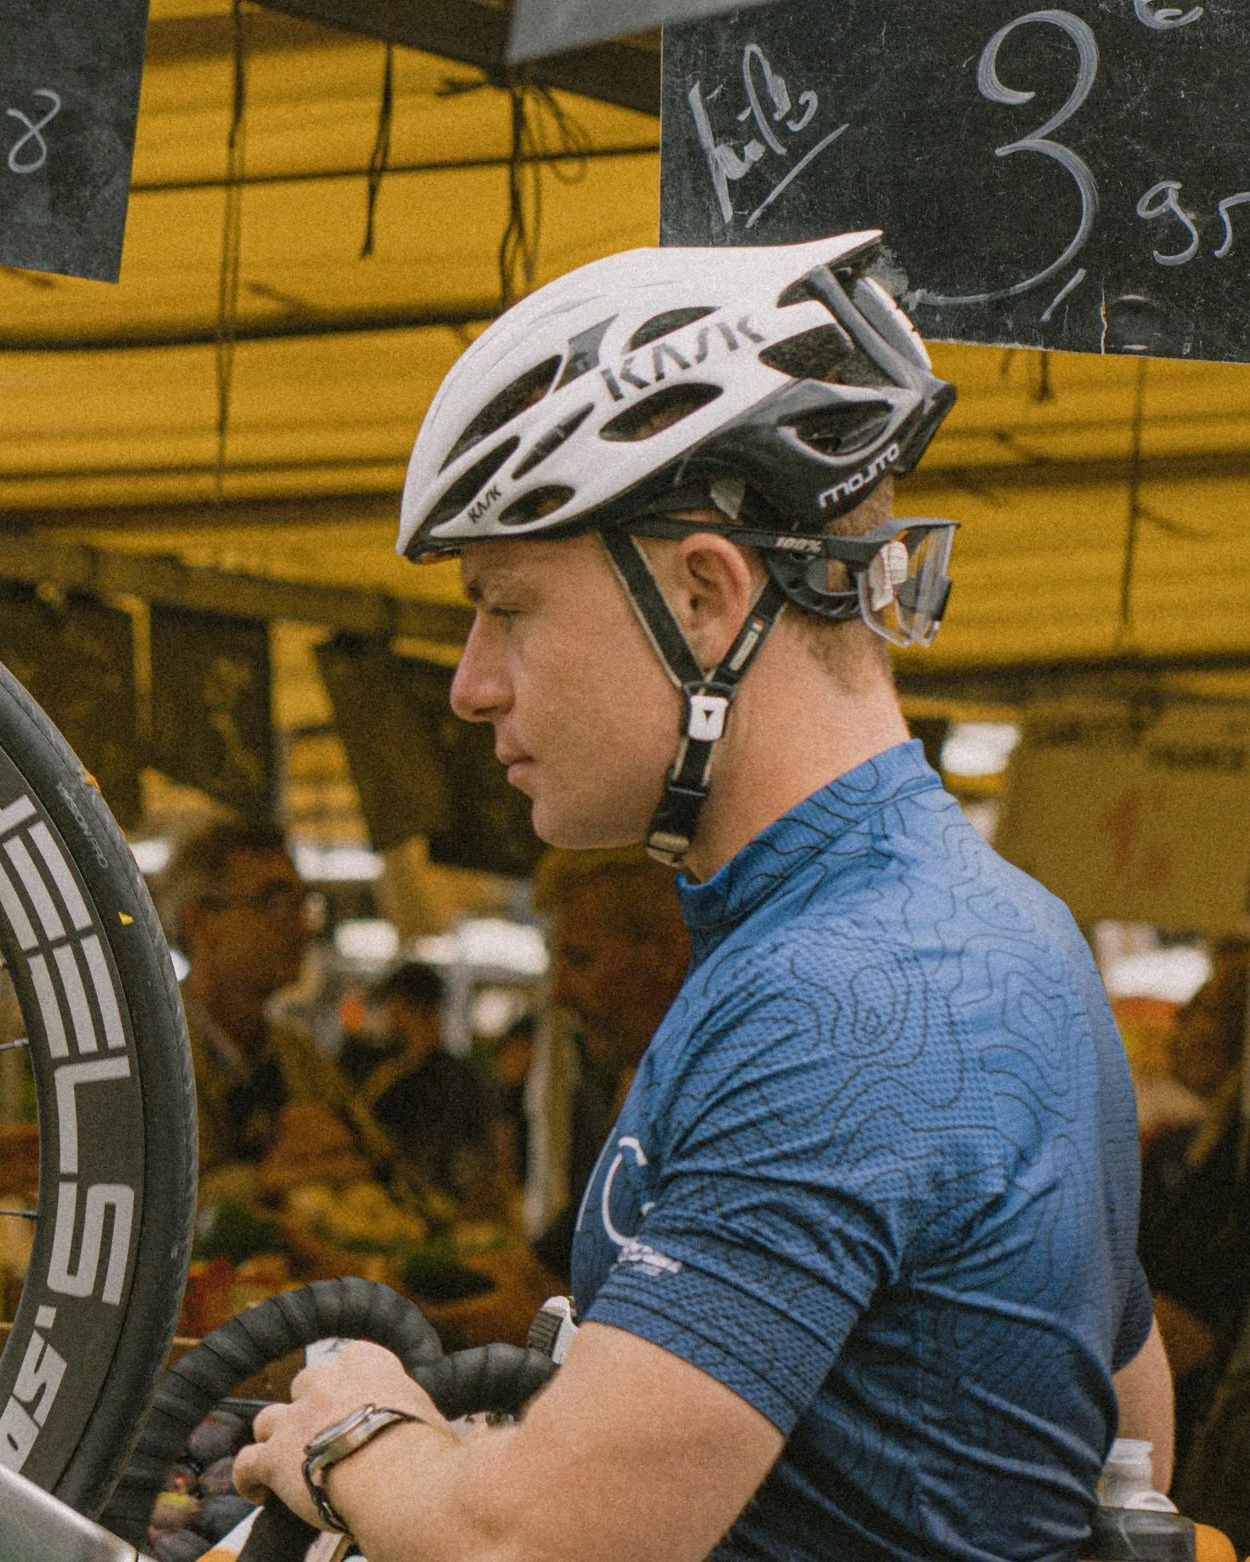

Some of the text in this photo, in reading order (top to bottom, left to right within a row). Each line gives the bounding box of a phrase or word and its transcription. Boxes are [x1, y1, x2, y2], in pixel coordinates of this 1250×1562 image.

[597, 313, 769, 402] KASK
[467, 485, 502, 524] KASK
[774, 536, 823, 554] 100%
